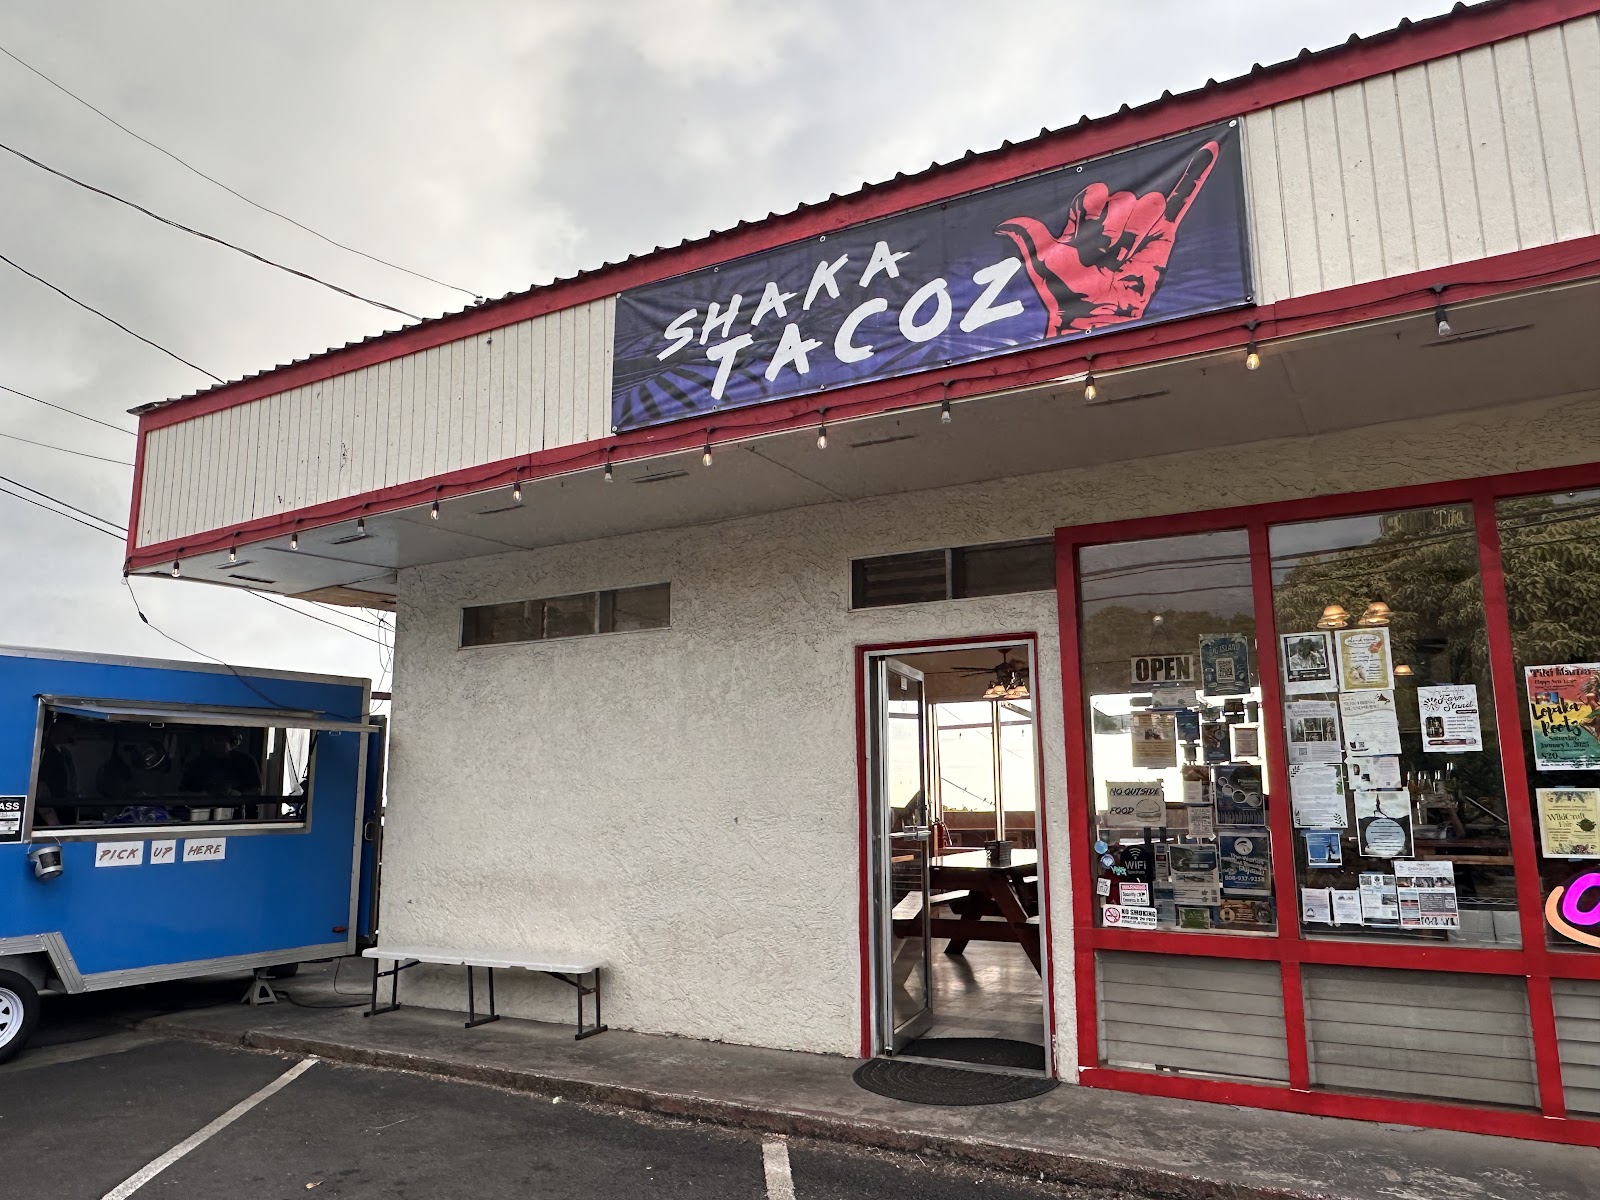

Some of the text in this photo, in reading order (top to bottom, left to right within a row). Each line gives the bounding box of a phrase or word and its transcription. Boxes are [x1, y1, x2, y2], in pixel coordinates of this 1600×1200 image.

[657, 240, 910, 361] SHAKA
[706, 257, 1025, 400] TACOZ
[1219, 643, 1241, 653] ISLAND
[1135, 656, 1191, 682] OPEN
[1437, 694, 1466, 704] Farm
[1443, 701, 1474, 711] Stand
[1531, 697, 1580, 723] Lopaka
[1541, 715, 1582, 737] Rootz
[1110, 787, 1160, 796] NO OUTSIDE
[1109, 806, 1135, 815] FOOD
[99, 844, 222, 862] PICK UP HERE
[1124, 860, 1147, 870] WiFi
[1130, 909, 1156, 917] SMOKING
